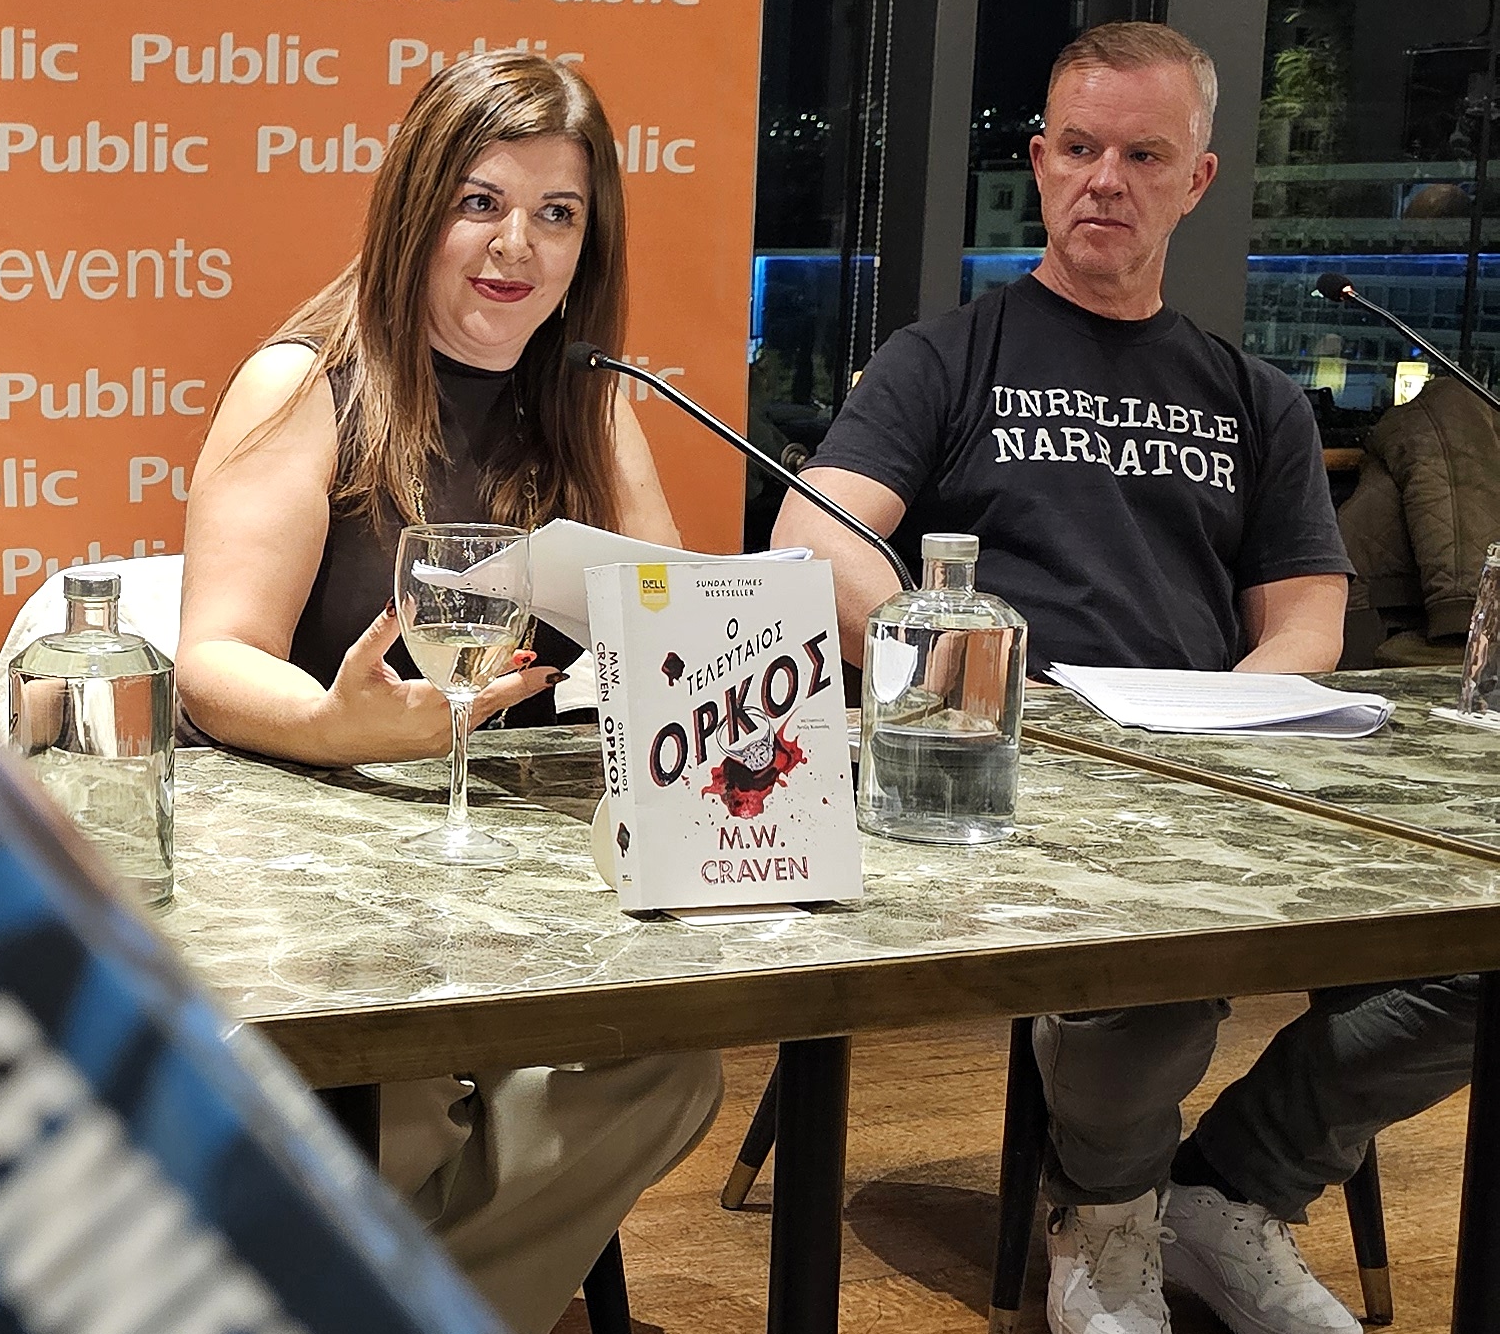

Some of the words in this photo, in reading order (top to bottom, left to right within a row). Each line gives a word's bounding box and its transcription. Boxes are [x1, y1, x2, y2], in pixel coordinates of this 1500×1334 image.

[132, 33, 338, 85] Public
[257, 124, 400, 173] Pub
[613, 125, 695, 173] lic
[992, 385, 1238, 443] UNRELIABLE
[992, 427, 1235, 493] NARRATOR
[696, 579, 732, 587] SUNDAY
[737, 578, 763, 587] TIMES
[705, 589, 754, 597] BESTSELLER
[727, 618, 739, 639] Ο
[596, 642, 610, 703] CRAVEN
[687, 620, 783, 695] ΤΕΛΕΥΤΑΙΟΣ
[650, 630, 831, 787] ΟΡΚΟΣ
[604, 716, 621, 797] ΟΡΚΟΣ
[719, 824, 786, 850] M.W.
[701, 856, 809, 884] CRAVEN
